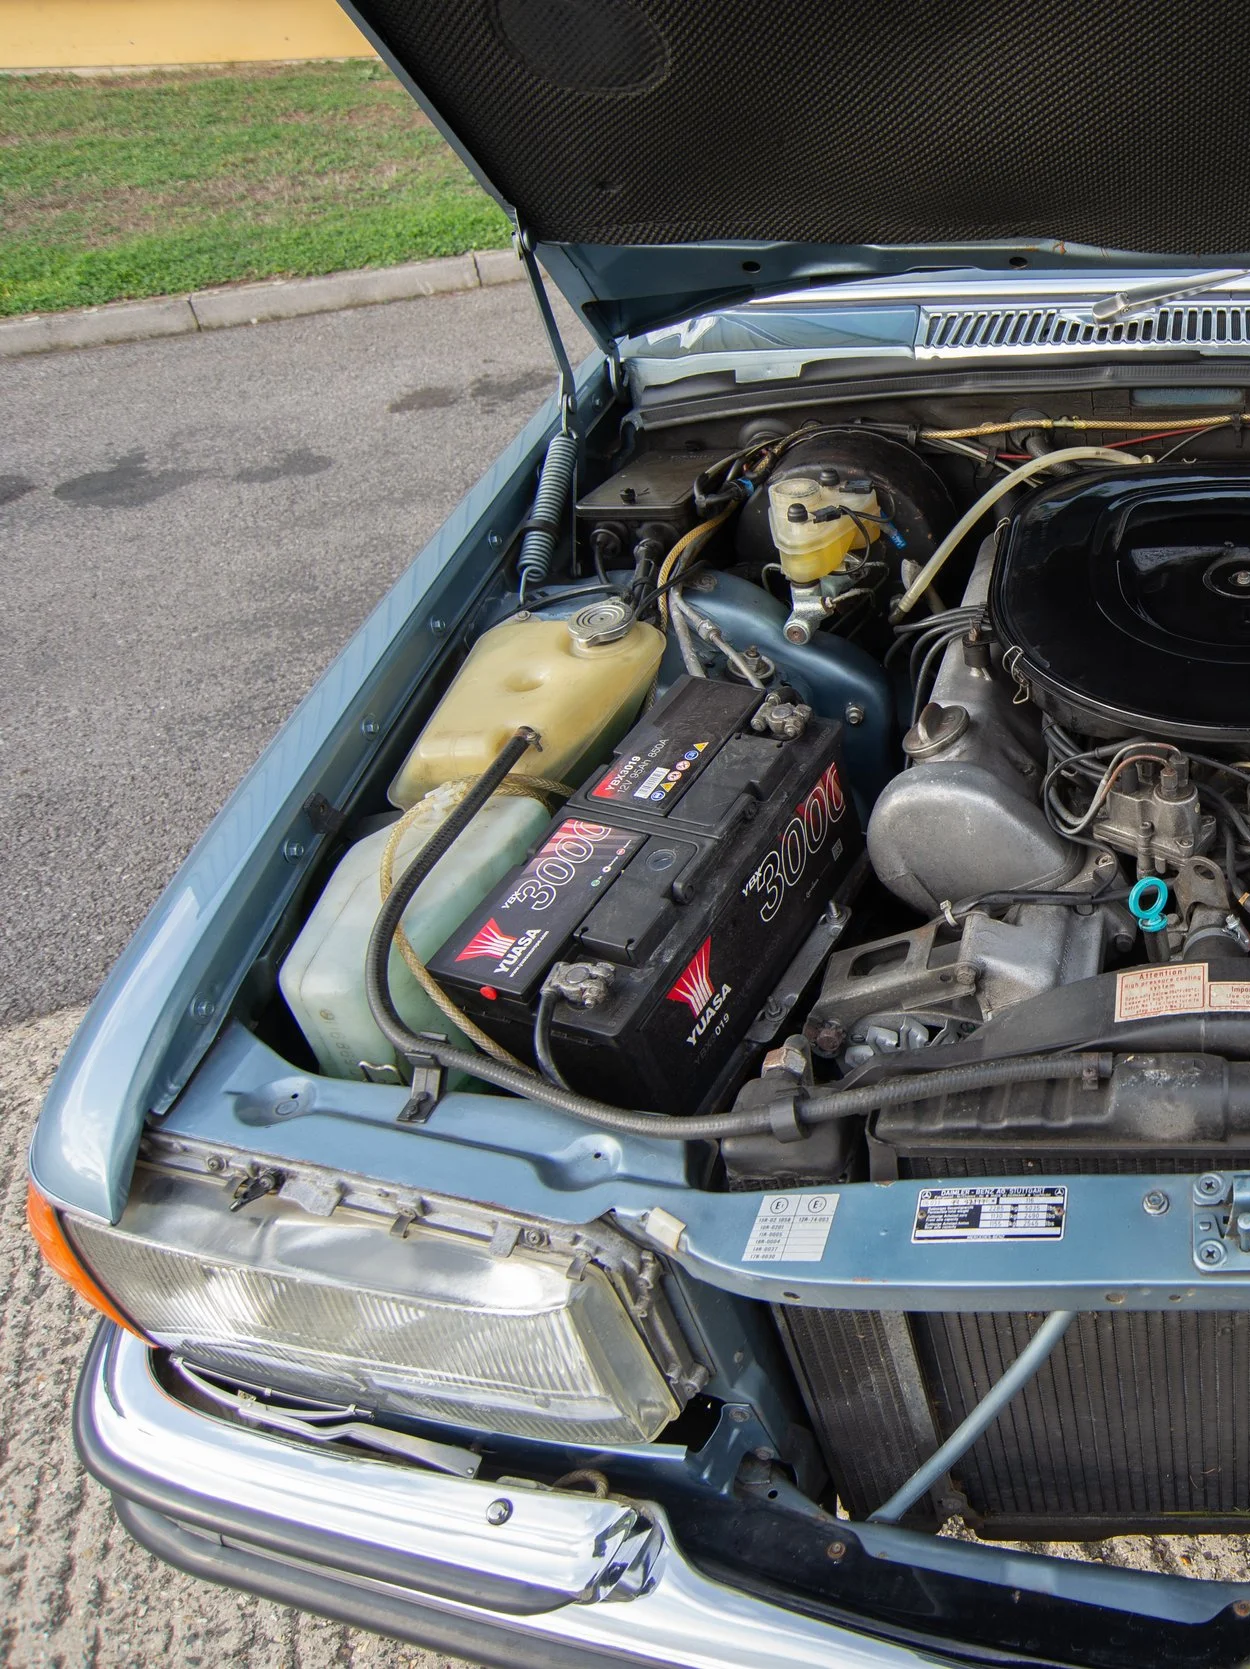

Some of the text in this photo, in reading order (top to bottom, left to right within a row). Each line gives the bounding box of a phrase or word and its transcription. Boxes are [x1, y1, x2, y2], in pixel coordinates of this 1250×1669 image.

[605, 756, 641, 791] YBX3019
[617, 738, 669, 793] 12V 95Ah 850A
[742, 867, 763, 897] YBX
[501, 891, 521, 909] YBX
[494, 929, 541, 974] YUASA
[1139, 968, 1188, 980] Attention!
[1141, 977, 1174, 987] pressure
[1176, 974, 1202, 982] cooling
[686, 984, 731, 1046] YUASA
[940, 1189, 970, 1197] DAIMLER
[975, 1188, 994, 1196] BENZ
[1009, 1187, 1046, 1195] STUTTGART
